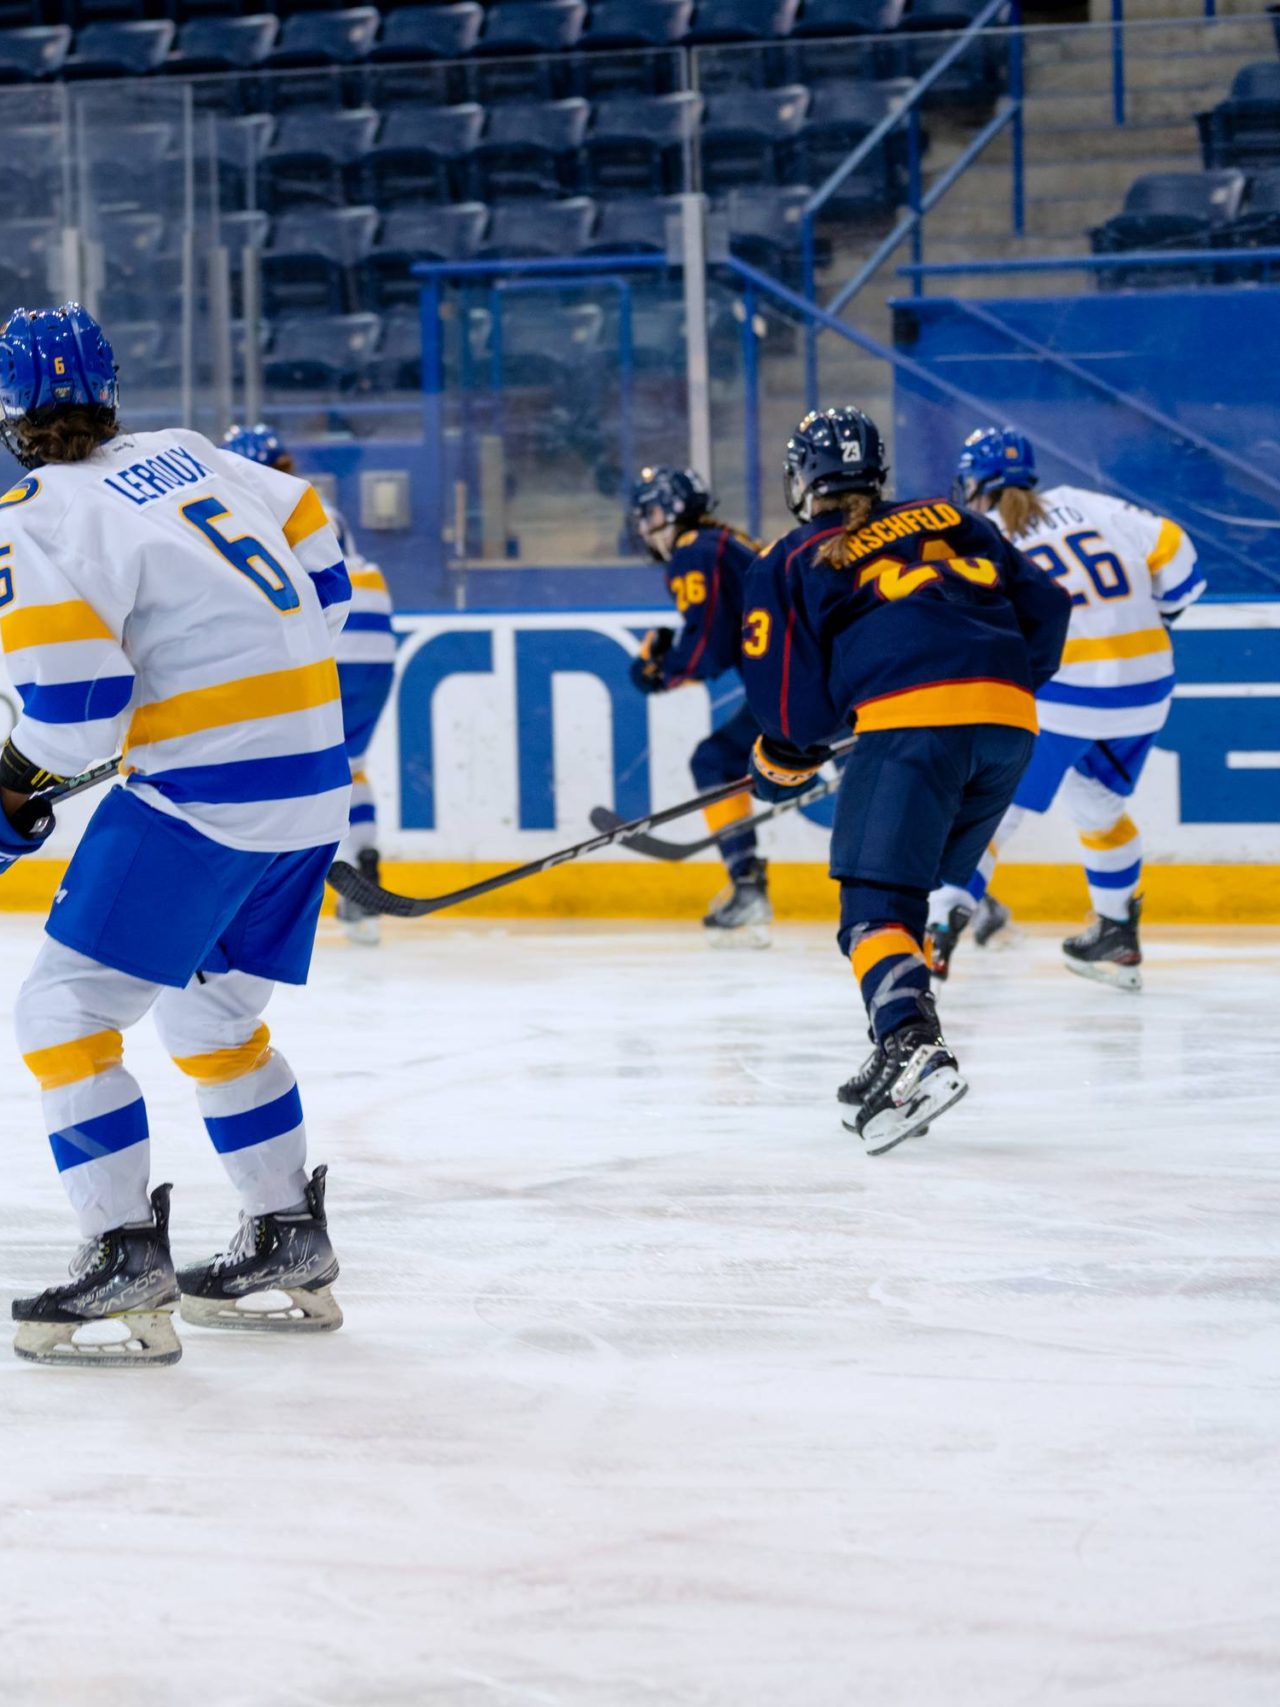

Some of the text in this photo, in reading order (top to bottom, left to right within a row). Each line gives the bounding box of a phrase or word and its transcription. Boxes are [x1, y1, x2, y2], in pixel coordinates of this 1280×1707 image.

[53, 356, 66, 375] 6
[103, 445, 215, 506] LEROUX
[840, 441, 861, 463] 23
[179, 494, 301, 616] 6
[846, 502, 962, 563] RSCHFELD
